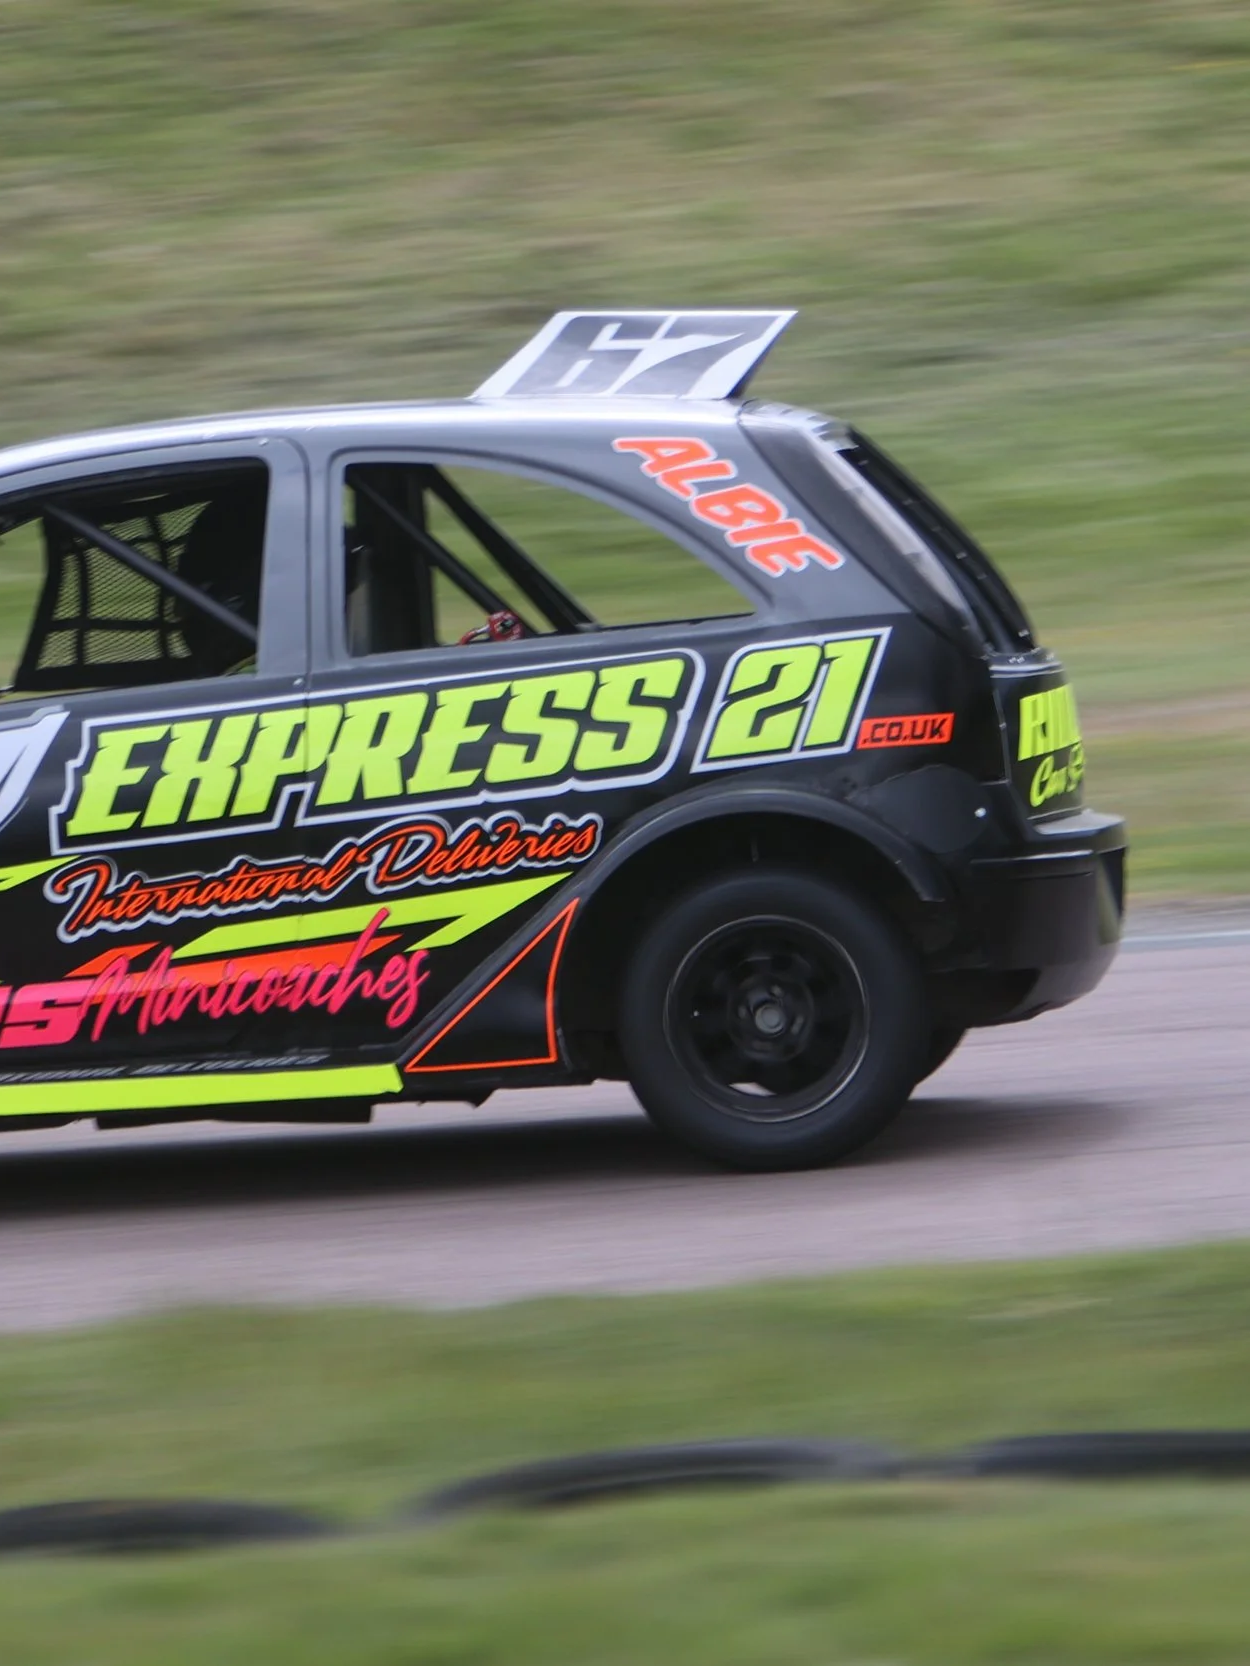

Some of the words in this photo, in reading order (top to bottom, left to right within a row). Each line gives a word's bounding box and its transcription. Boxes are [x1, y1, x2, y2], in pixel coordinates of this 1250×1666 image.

[502, 313, 783, 397] 67
[612, 436, 844, 578] ALBIE
[66, 657, 686, 837] EXPRESS
[706, 635, 876, 760] 21
[52, 842, 356, 935] International
[354, 819, 597, 884] Deliveries
